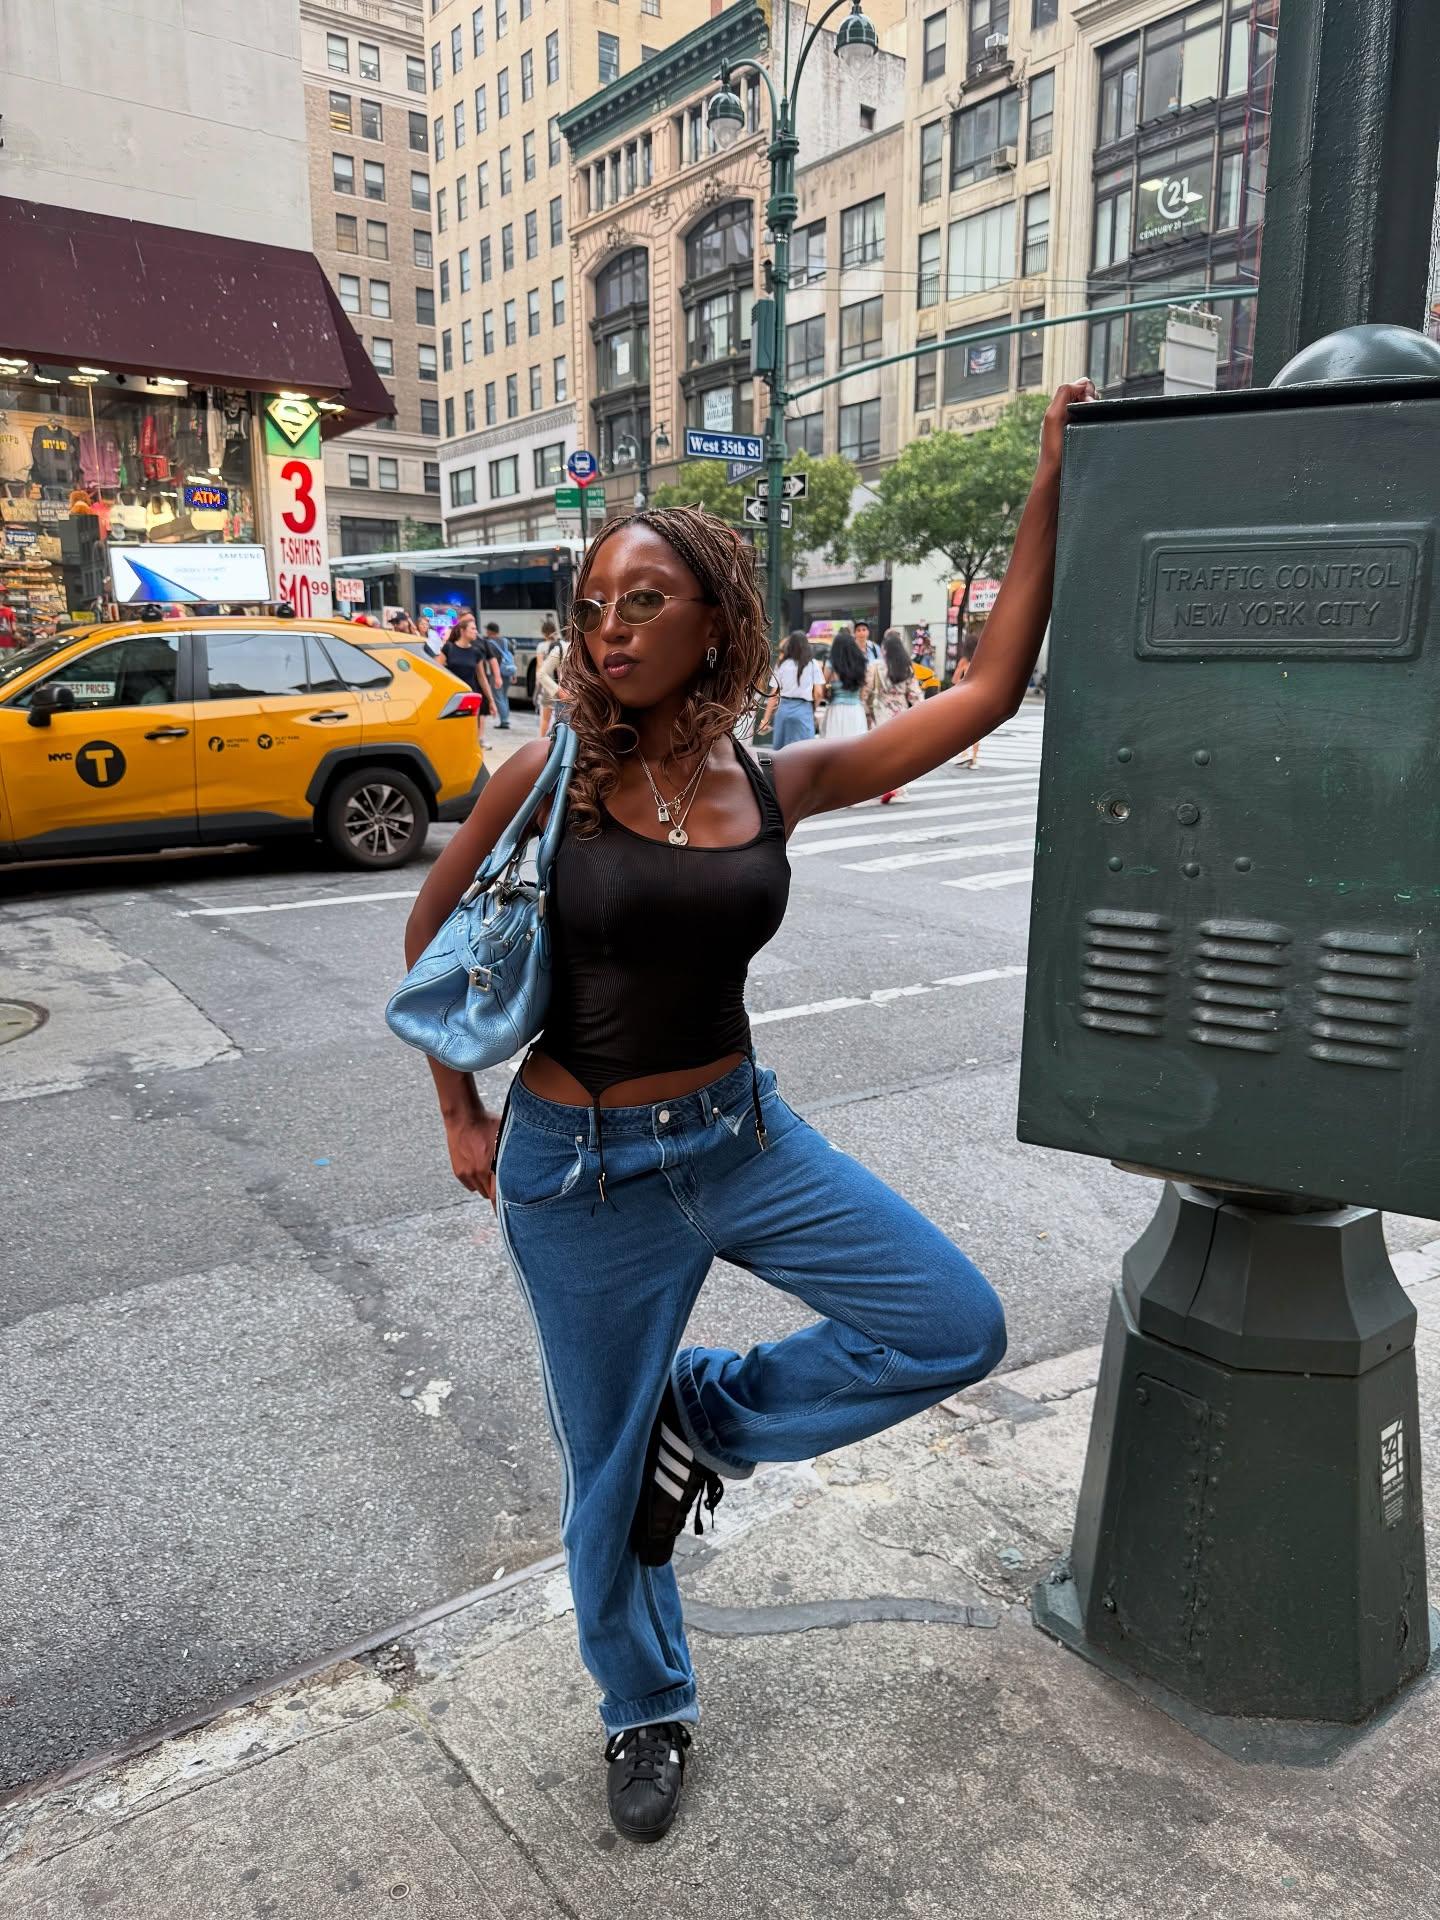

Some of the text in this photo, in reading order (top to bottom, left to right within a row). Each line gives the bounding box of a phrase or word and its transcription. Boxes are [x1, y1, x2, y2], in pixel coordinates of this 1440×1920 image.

[1140, 222, 1174, 240] CENTURY
[690, 436, 759, 457] West 35th St
[193, 491, 220, 504] ATM
[281, 461, 316, 534] 3
[280, 538, 321, 566] T-SHIRTS
[1161, 563, 1401, 591] TRAFFIC CONTROL
[1174, 601, 1381, 627] NEW YORK CITY
[86, 684, 110, 695] PRICES
[48, 753, 72, 762] NYC
[85, 749, 114, 782] T
